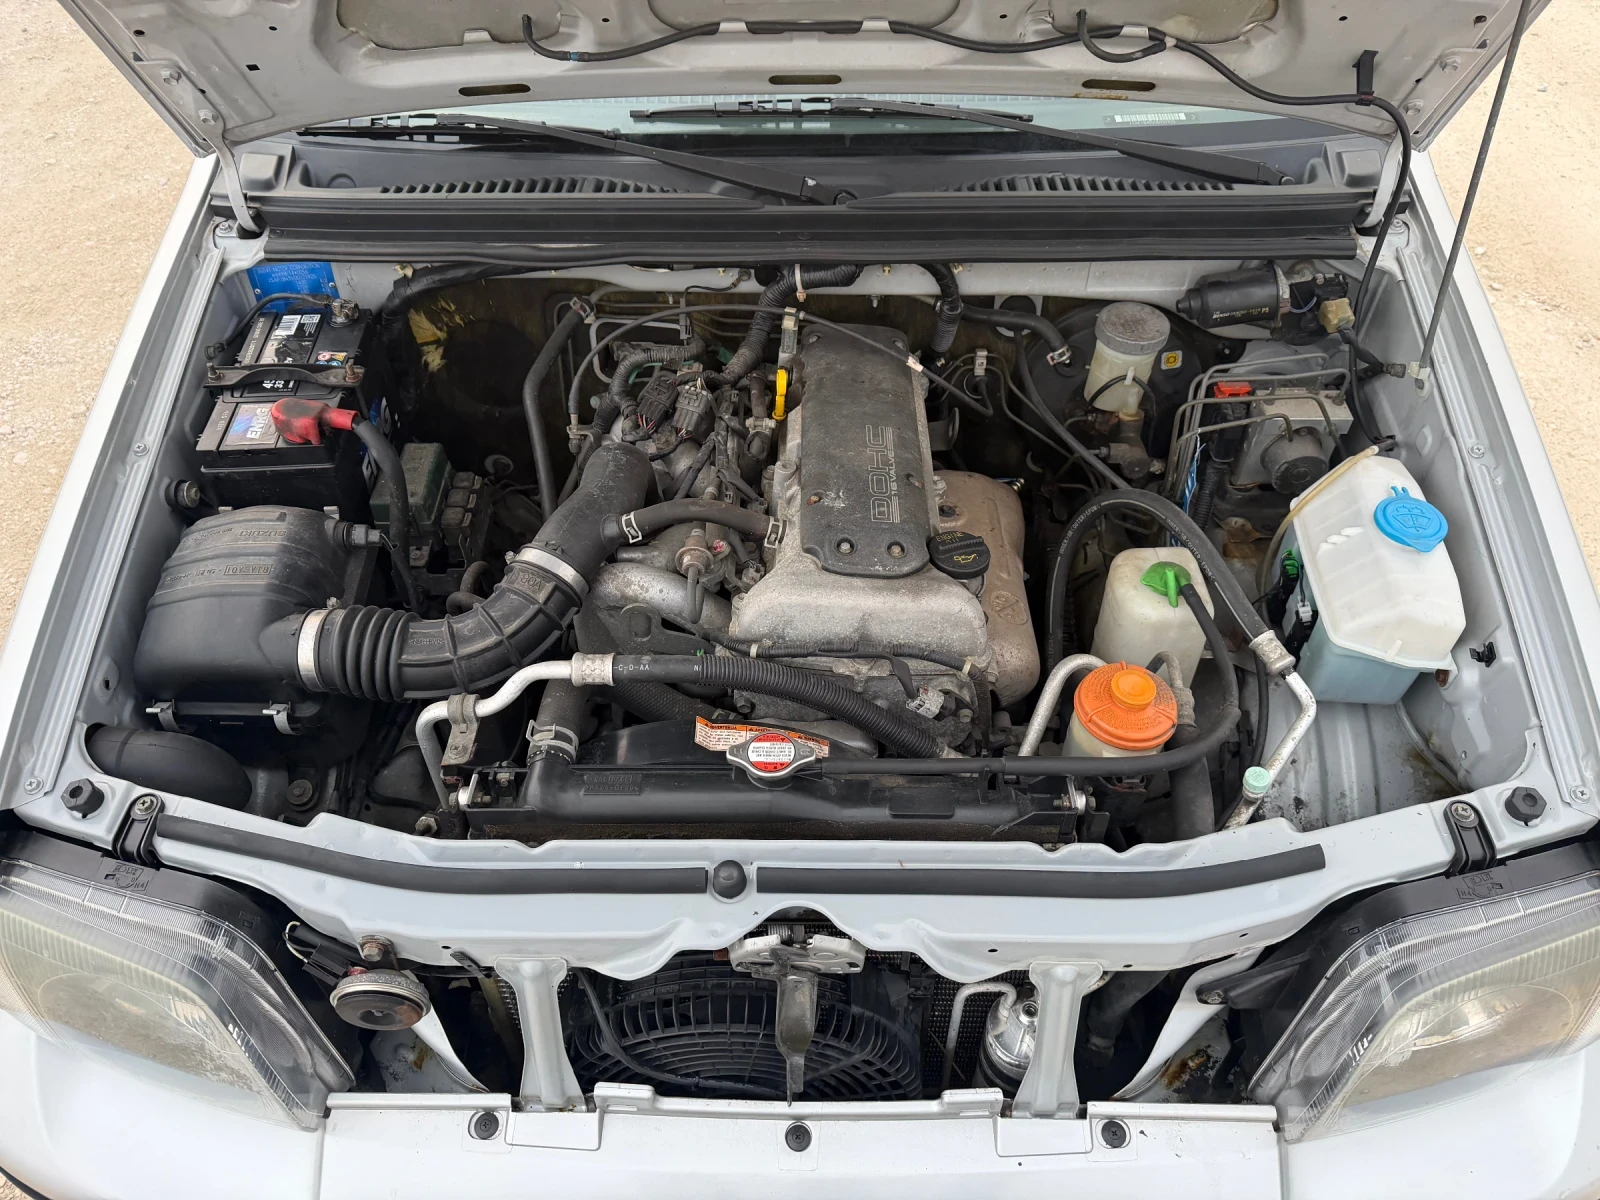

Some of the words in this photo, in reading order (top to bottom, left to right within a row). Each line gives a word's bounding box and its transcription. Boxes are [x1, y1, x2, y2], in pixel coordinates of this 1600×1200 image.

[865, 424, 893, 523] DOHC
[239, 529, 287, 537] SUZUKI
[935, 531, 965, 542] ENGINE
